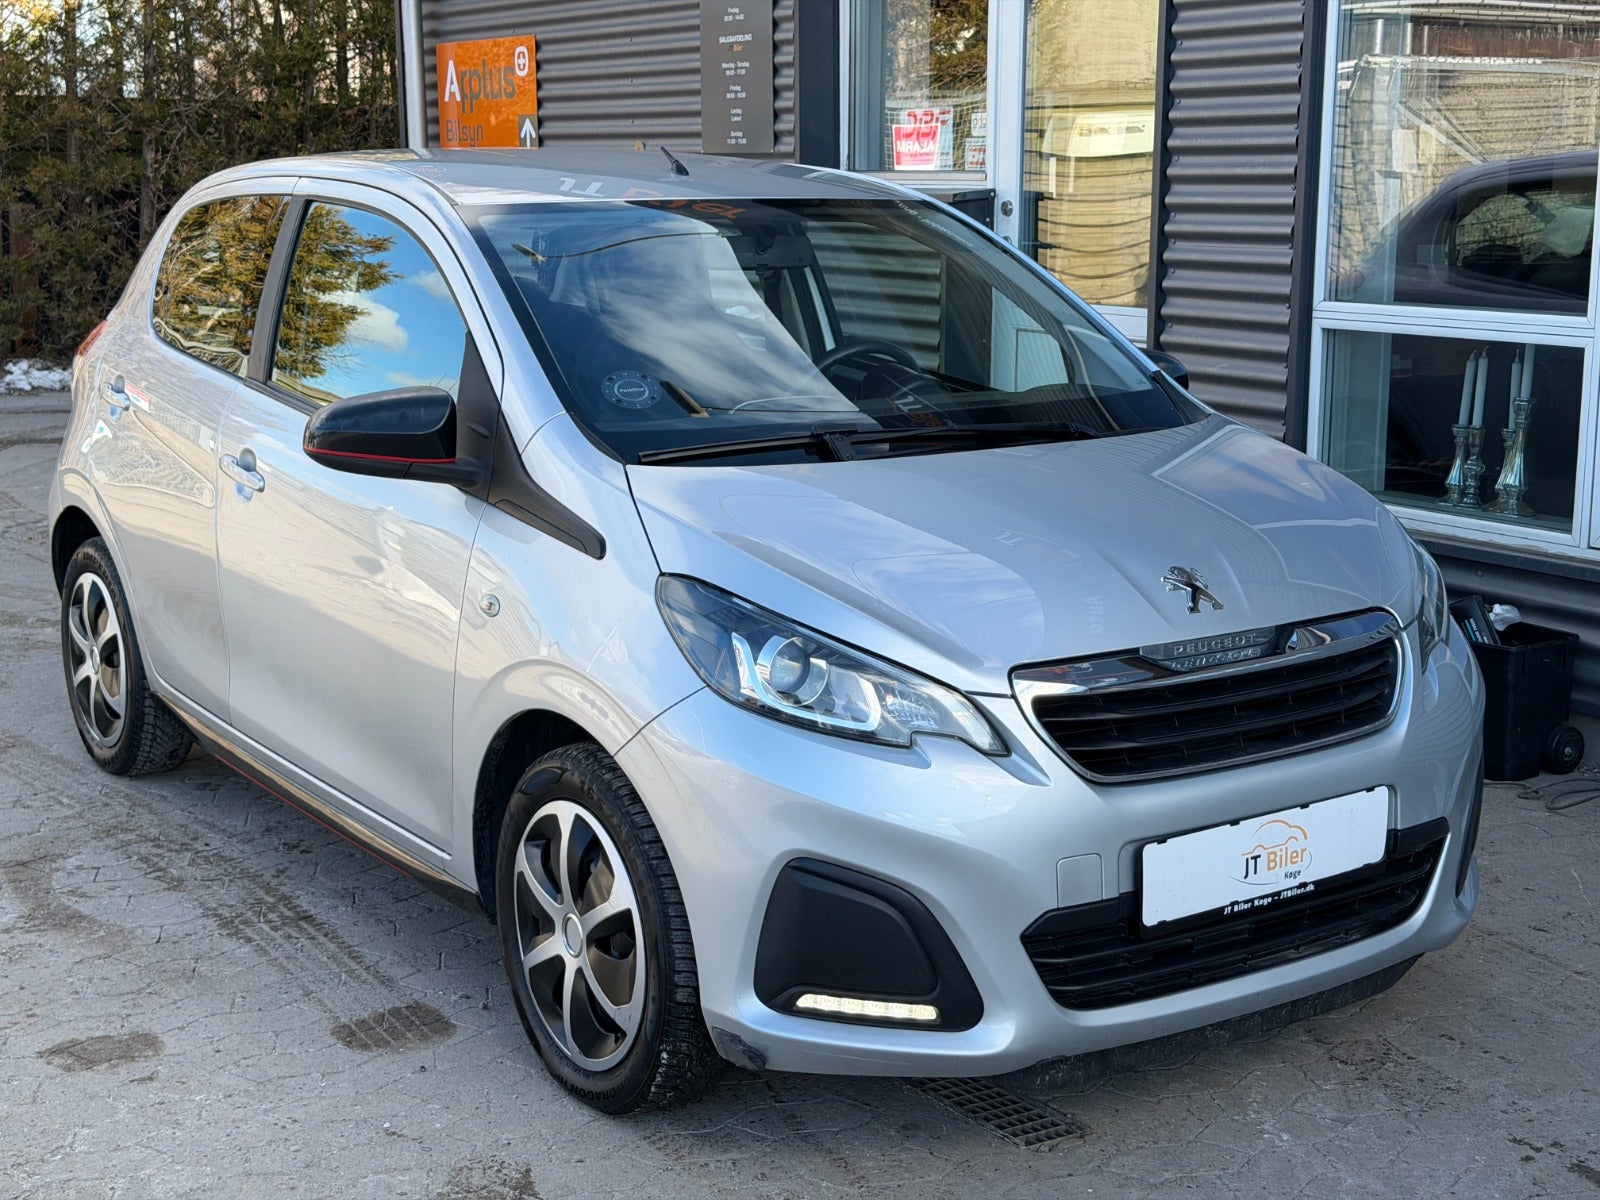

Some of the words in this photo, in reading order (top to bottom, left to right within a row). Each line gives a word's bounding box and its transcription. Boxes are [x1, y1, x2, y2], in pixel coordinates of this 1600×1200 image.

[446, 119, 484, 147] Bilsyn
[1174, 632, 1256, 656] PEUGEOT
[1243, 854, 1262, 879] JT
[1267, 847, 1307, 872] Biler
[1223, 906, 1233, 915] JT
[1233, 902, 1252, 912] Biler
[1279, 883, 1315, 899] JTBiler.dk
